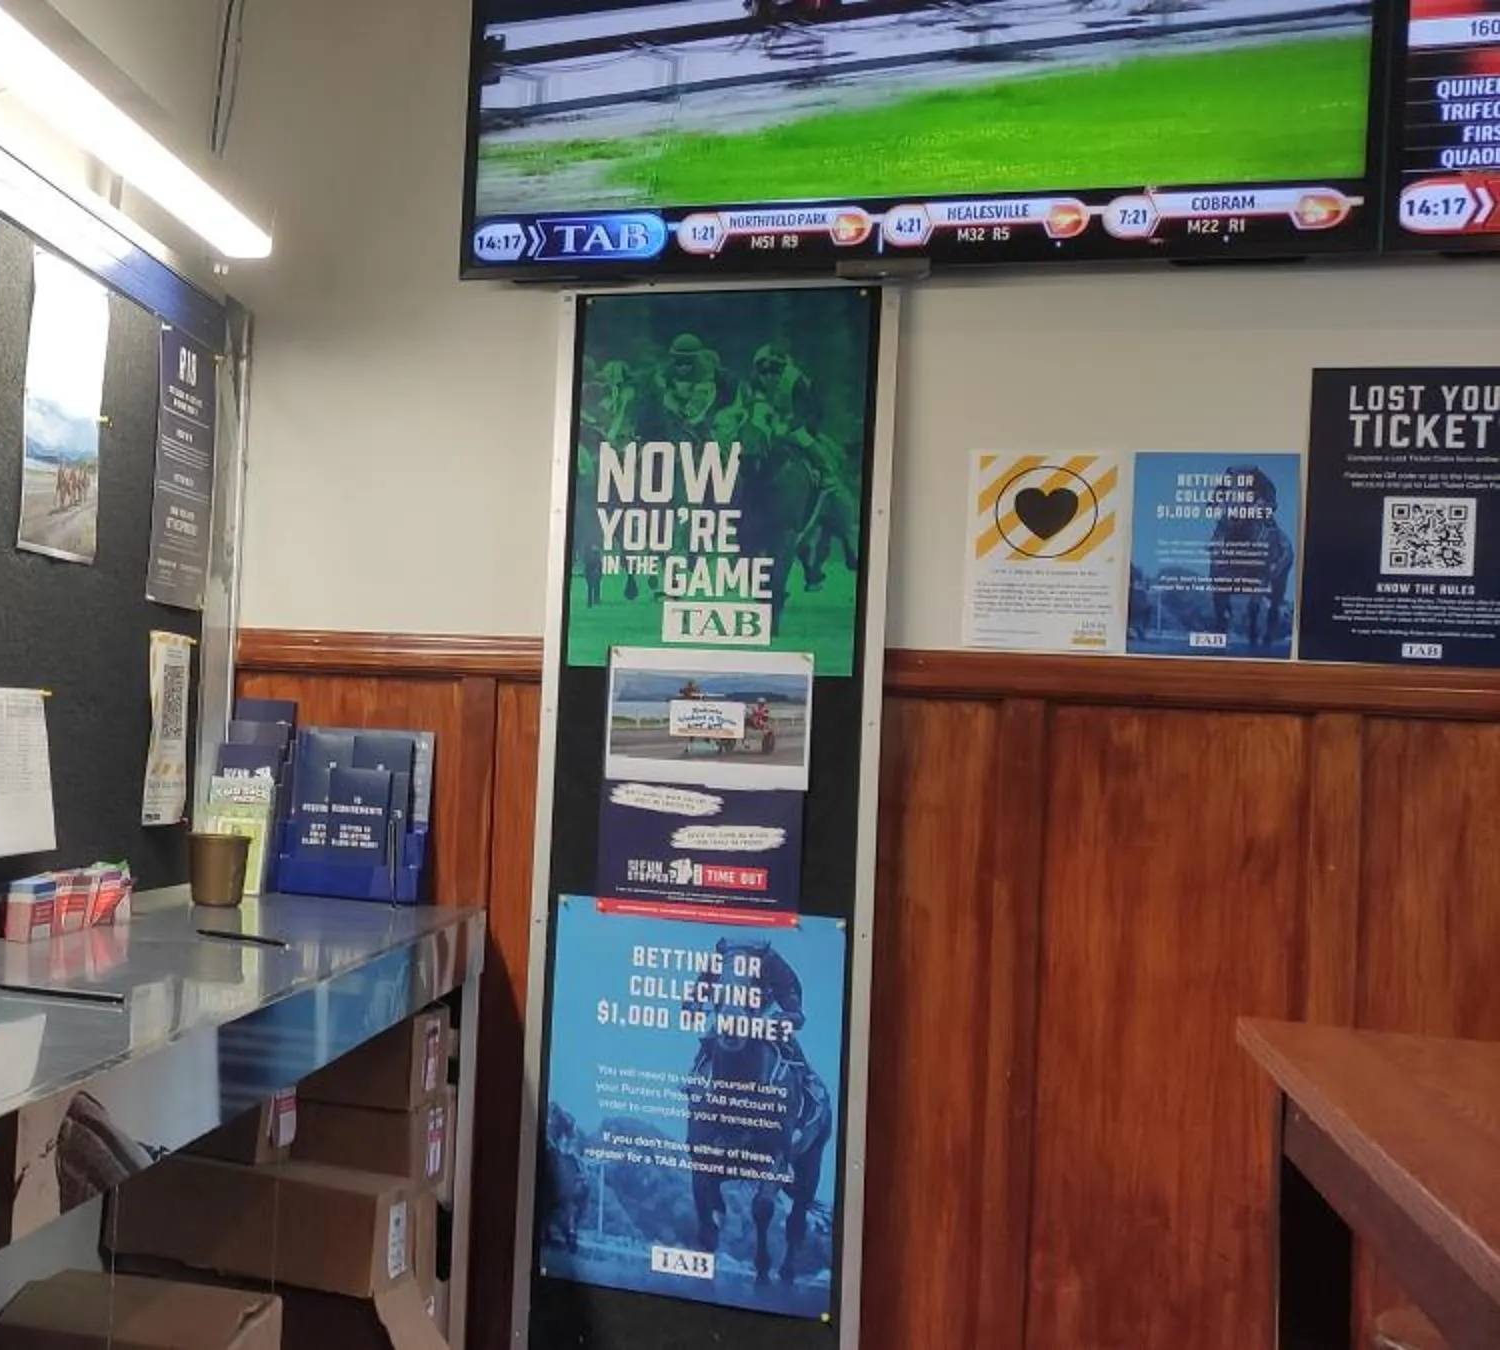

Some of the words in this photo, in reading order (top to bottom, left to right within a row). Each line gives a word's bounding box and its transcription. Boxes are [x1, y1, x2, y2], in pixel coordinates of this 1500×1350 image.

[947, 203, 1030, 221] HEALESVILLE
[1191, 195, 1256, 212] COBRAM
[1406, 197, 1467, 216] 14:17
[797, 212, 829, 225] PARK
[895, 218, 922, 234] 4:21
[1119, 208, 1148, 225] 7:21
[690, 225, 716, 241] 1:21
[957, 227, 985, 242] M32
[992, 227, 1011, 241] R5
[1187, 219, 1220, 234] M22
[476, 232, 522, 251] 14:17
[551, 223, 651, 254] TAB
[1349, 385, 1426, 412] LOST
[1441, 385, 1500, 412] YOU
[1349, 413, 1500, 449] TICKET
[597, 441, 742, 503] NOW
[1177, 473, 1232, 487] BETTING
[1237, 475, 1254, 487] OR
[1175, 490, 1255, 503] COLLECTING
[1205, 506, 1224, 519] OR
[1227, 506, 1273, 519] MORE?
[596, 507, 743, 553] YOU'RE
[601, 556, 620, 574] IN
[625, 555, 659, 575] THE
[663, 556, 774, 599] GAME
[1376, 582, 1410, 594] KNOW
[1414, 583, 1435, 594] THE
[1439, 584, 1476, 595] RULES
[671, 608, 762, 637] TAB
[1407, 644, 1439, 656] TAB
[706, 869, 736, 883] TIME
[739, 872, 765, 886] OUT
[633, 945, 723, 975] BETTING
[733, 956, 762, 978] OR
[629, 975, 761, 1008] COLLECTING
[679, 1009, 707, 1032] OR
[716, 1014, 794, 1042] MORE?
[598, 1065, 617, 1076] You
[681, 1075, 711, 1088] verify
[712, 1078, 757, 1091] yourself
[758, 1083, 787, 1098] using
[621, 1083, 662, 1098] Punters
[705, 1093, 727, 1105] TAB
[729, 1097, 775, 1112] Account
[777, 1102, 787, 1113] in
[641, 1104, 692, 1119] complete
[693, 1111, 718, 1122] your
[612, 1135, 633, 1145] you
[634, 1135, 662, 1148] don't
[663, 1140, 690, 1152] have
[693, 1144, 725, 1156] either
[727, 1148, 739, 1159] of
[583, 1147, 625, 1161] register
[627, 1151, 643, 1163] for
[643, 1156, 652, 1165] a
[654, 1155, 677, 1167] TAB
[678, 1158, 724, 1175] Account
[726, 1166, 738, 1176] at
[660, 1253, 709, 1274] TAB
